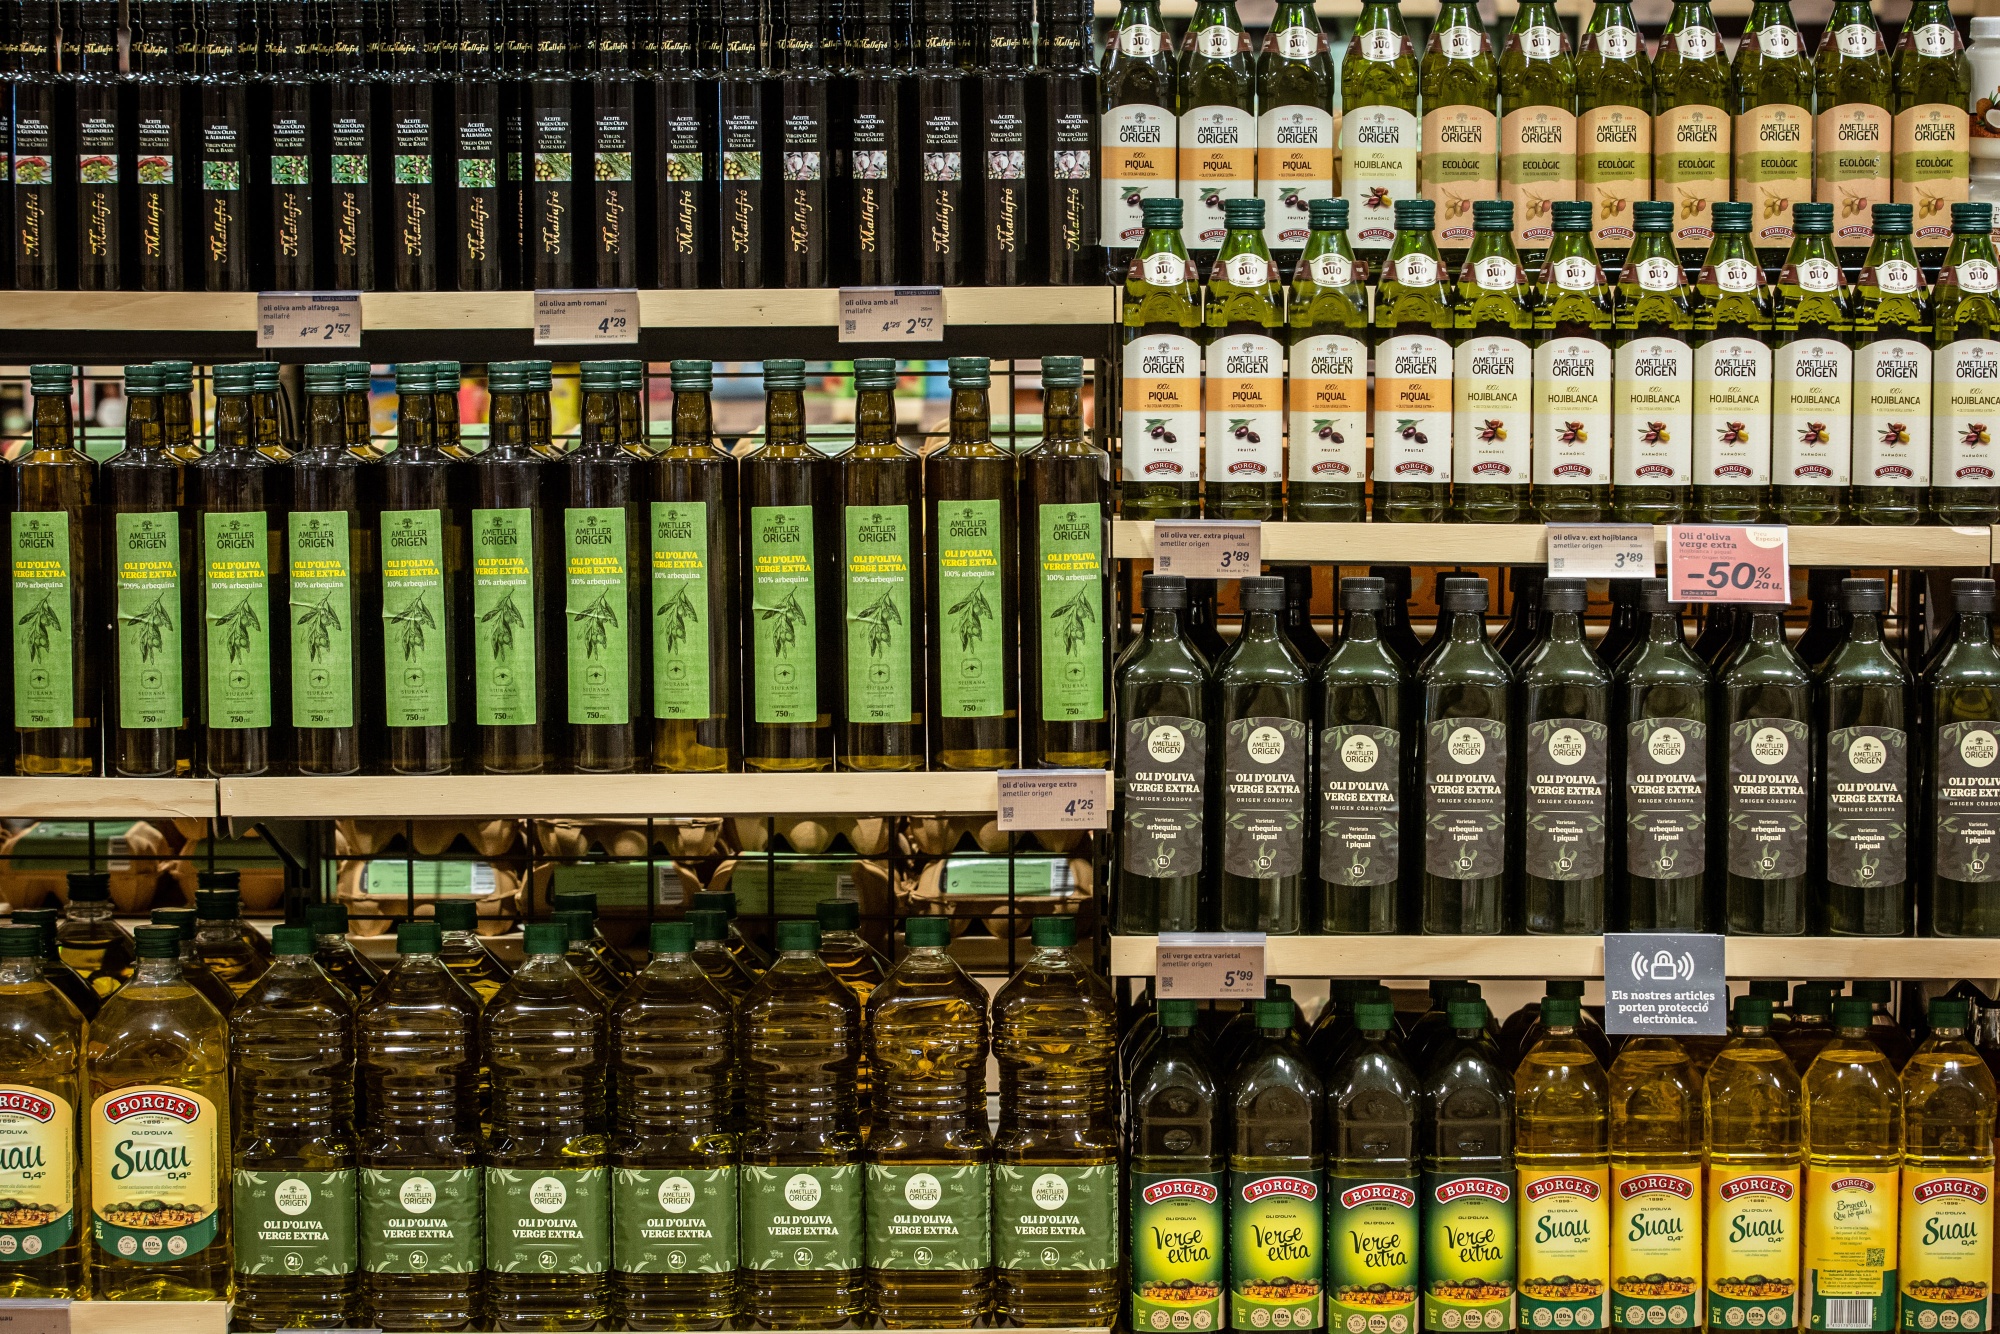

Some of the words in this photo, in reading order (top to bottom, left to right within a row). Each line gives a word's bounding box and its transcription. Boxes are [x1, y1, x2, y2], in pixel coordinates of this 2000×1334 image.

[1597, 125, 1636, 133] AMETLLER
[1597, 132, 1636, 142] ORIGEN
[1203, 162, 1232, 171] PIQUAL
[1354, 161, 1403, 170] HOJIBLANCA
[1598, 158, 1635, 169] ECOLÒGIC
[339, 192, 361, 256] Mallafré
[603, 190, 624, 254] Mallafré
[1362, 229, 1393, 238] BORGES
[1602, 228, 1630, 236] BORGES
[1155, 265, 1174, 275] DUO
[1143, 363, 1184, 374] ORIGEN
[1149, 392, 1178, 401] PIQUAL
[1710, 394, 1759, 403] HOJIBLANCA
[1149, 463, 1178, 471] BORGES
[1719, 465, 1747, 474] BORGES
[1696, 533, 1731, 541] d'oliva
[129, 539, 167, 549] ORIGEN
[1679, 541, 1707, 549] verge
[960, 549, 993, 558] D'OLIVA
[124, 562, 138, 570] OLI
[140, 561, 173, 570] D'OLIVA
[942, 559, 968, 567] VERGE
[969, 558, 997, 566] EXTRA
[120, 570, 147, 579] VERGE
[149, 569, 177, 578] EXTRA
[142, 582, 175, 590] arbequina
[1754, 580, 1769, 589] 2a
[1772, 582, 1782, 590] u.
[1152, 746, 1180, 754] ORIGEN
[1135, 773, 1152, 781] OLI
[1155, 773, 1195, 782] D'OLIVA
[1130, 783, 1163, 792] VERGE
[1165, 784, 1200, 793] EXTRA
[1612, 991, 1628, 999] Els
[1631, 991, 1671, 1000] nostres
[1674, 991, 1715, 1000] articles
[1619, 1004, 1655, 1013] porten
[1658, 1003, 1708, 1013] protecció
[1633, 1014, 1697, 1024] electrònica.
[117, 1096, 186, 1114] BORGES
[111, 1140, 192, 1180] Suau
[1629, 1178, 1685, 1192] BORGES
[1153, 1183, 1209, 1197] BORGES
[1834, 1212, 1846, 1221] Que
[1856, 1210, 1865, 1220] que
[264, 1221, 280, 1229] OLI
[283, 1221, 323, 1230] D'OLIVA
[1628, 1213, 1683, 1242] Suau
[258, 1232, 292, 1240] VERGE
[294, 1232, 329, 1240] EXTRA
[1152, 1226, 1203, 1249] Verge
[1167, 1245, 1211, 1263] extra
[287, 1256, 300, 1265] 2L
